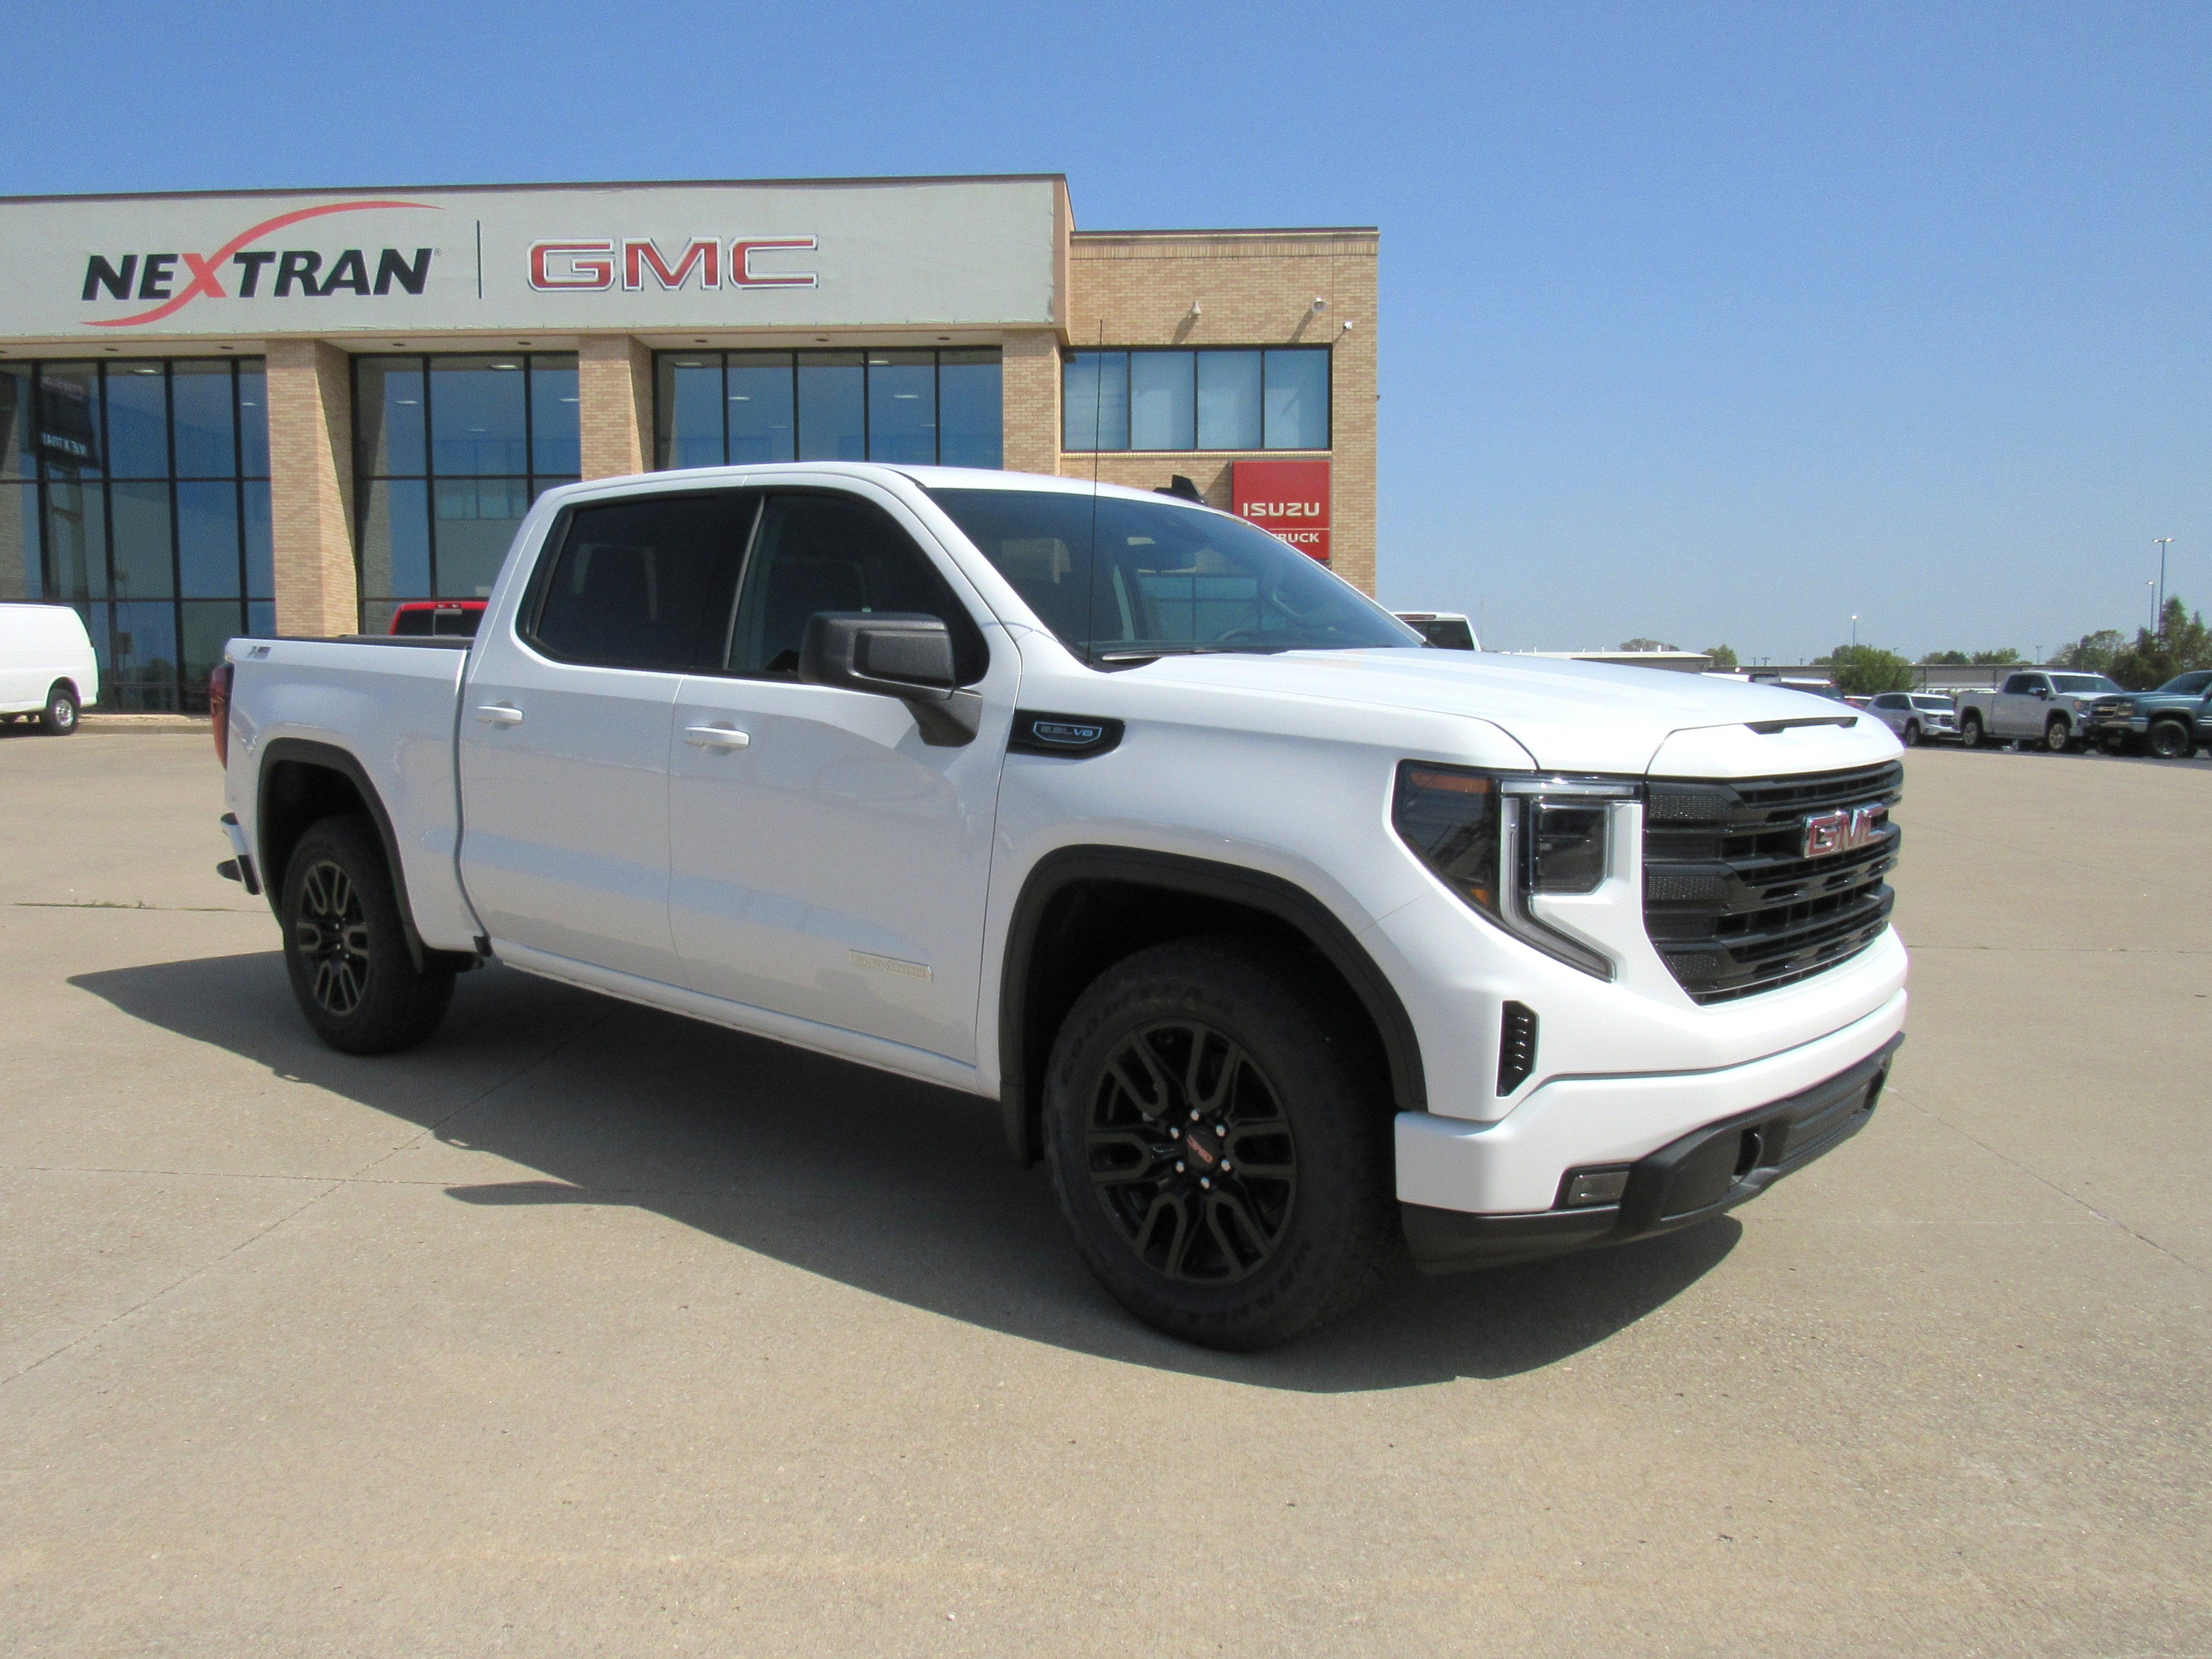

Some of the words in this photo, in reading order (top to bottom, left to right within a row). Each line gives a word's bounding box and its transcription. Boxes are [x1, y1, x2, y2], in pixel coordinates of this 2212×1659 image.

[81, 247, 433, 301] NEXTRAN
[527, 234, 819, 293] GMC
[1243, 502, 1320, 517] ISUZU
[1273, 532, 1320, 543] RUCK
[1804, 802, 1886, 858] GMC
